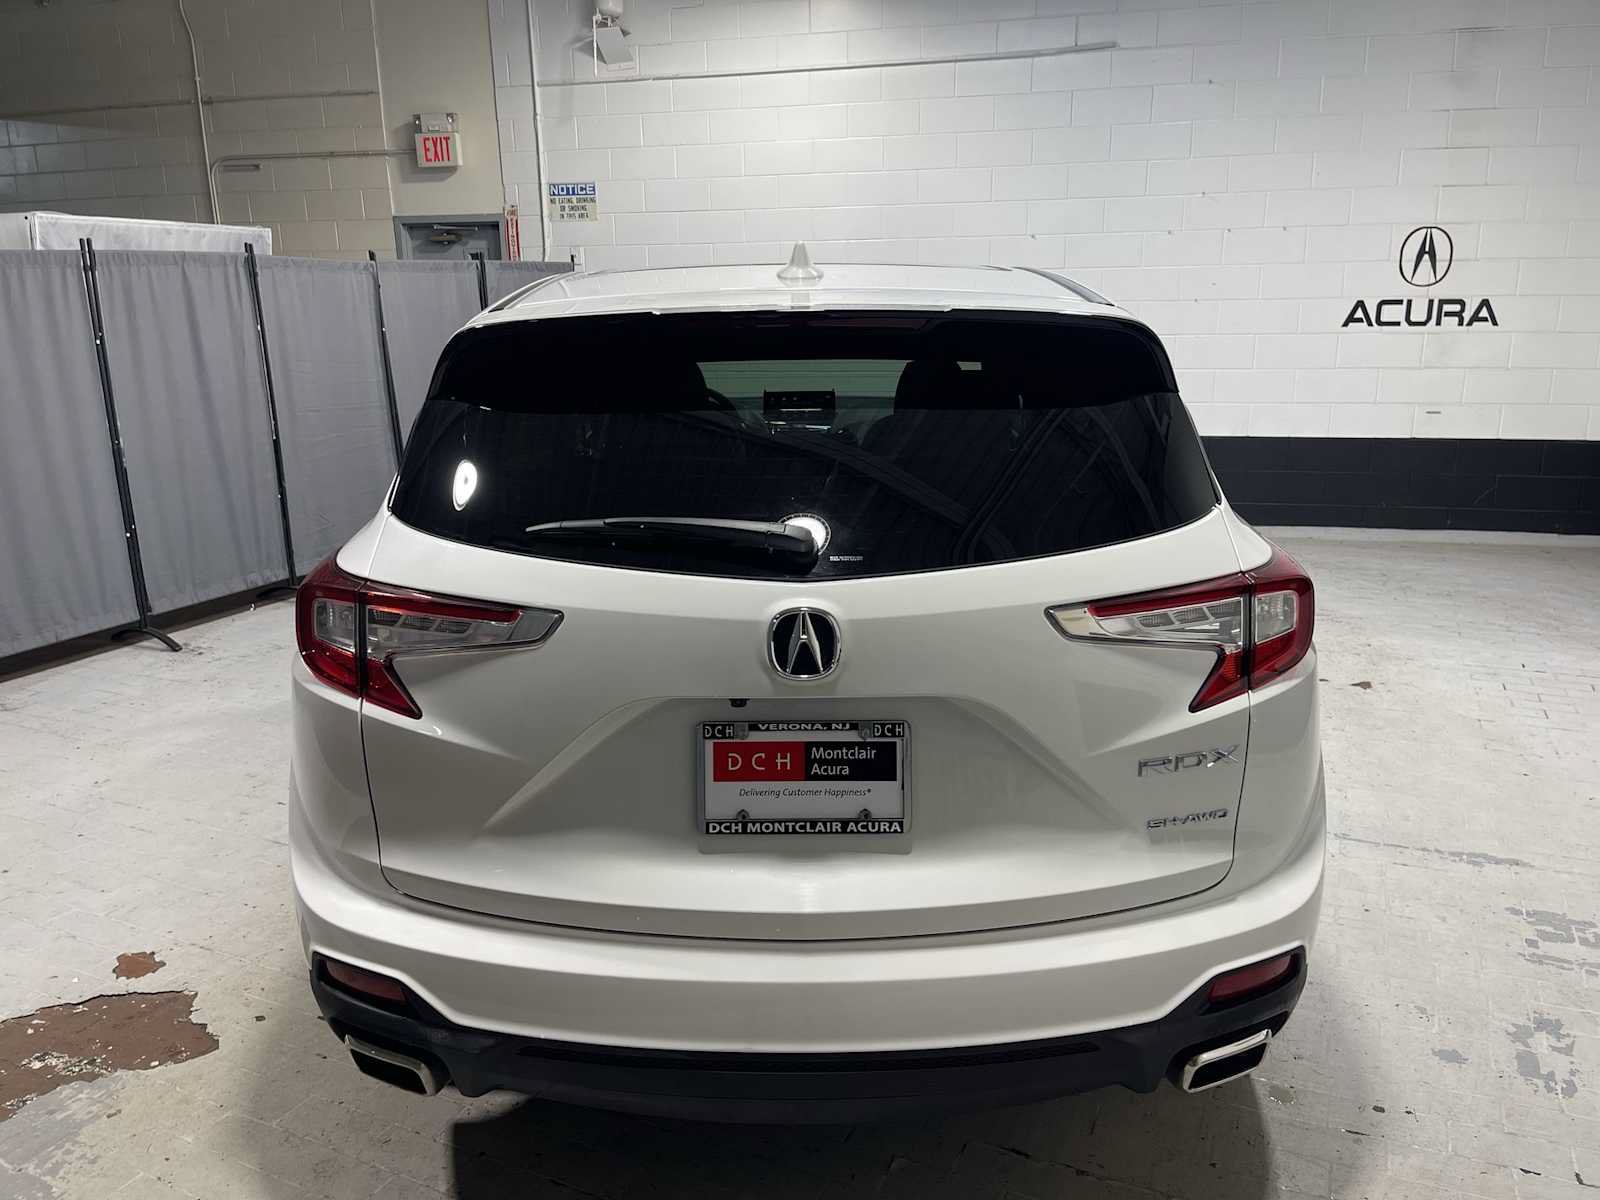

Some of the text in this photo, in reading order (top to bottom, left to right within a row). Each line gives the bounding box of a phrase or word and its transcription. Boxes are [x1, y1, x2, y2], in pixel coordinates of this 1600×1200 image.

[423, 136, 450, 162] EXIT
[550, 184, 595, 195] NOTICE
[1341, 299, 1499, 327] ACURA
[758, 723, 850, 731] VERONA, NJ
[811, 747, 877, 760] Montclair
[1138, 745, 1239, 777] RDX
[811, 763, 850, 776] Acura
[739, 787, 780, 798] Delivering
[782, 788, 822, 797] Customer
[708, 821, 901, 833] DCH MONTCLAIR ACURA
